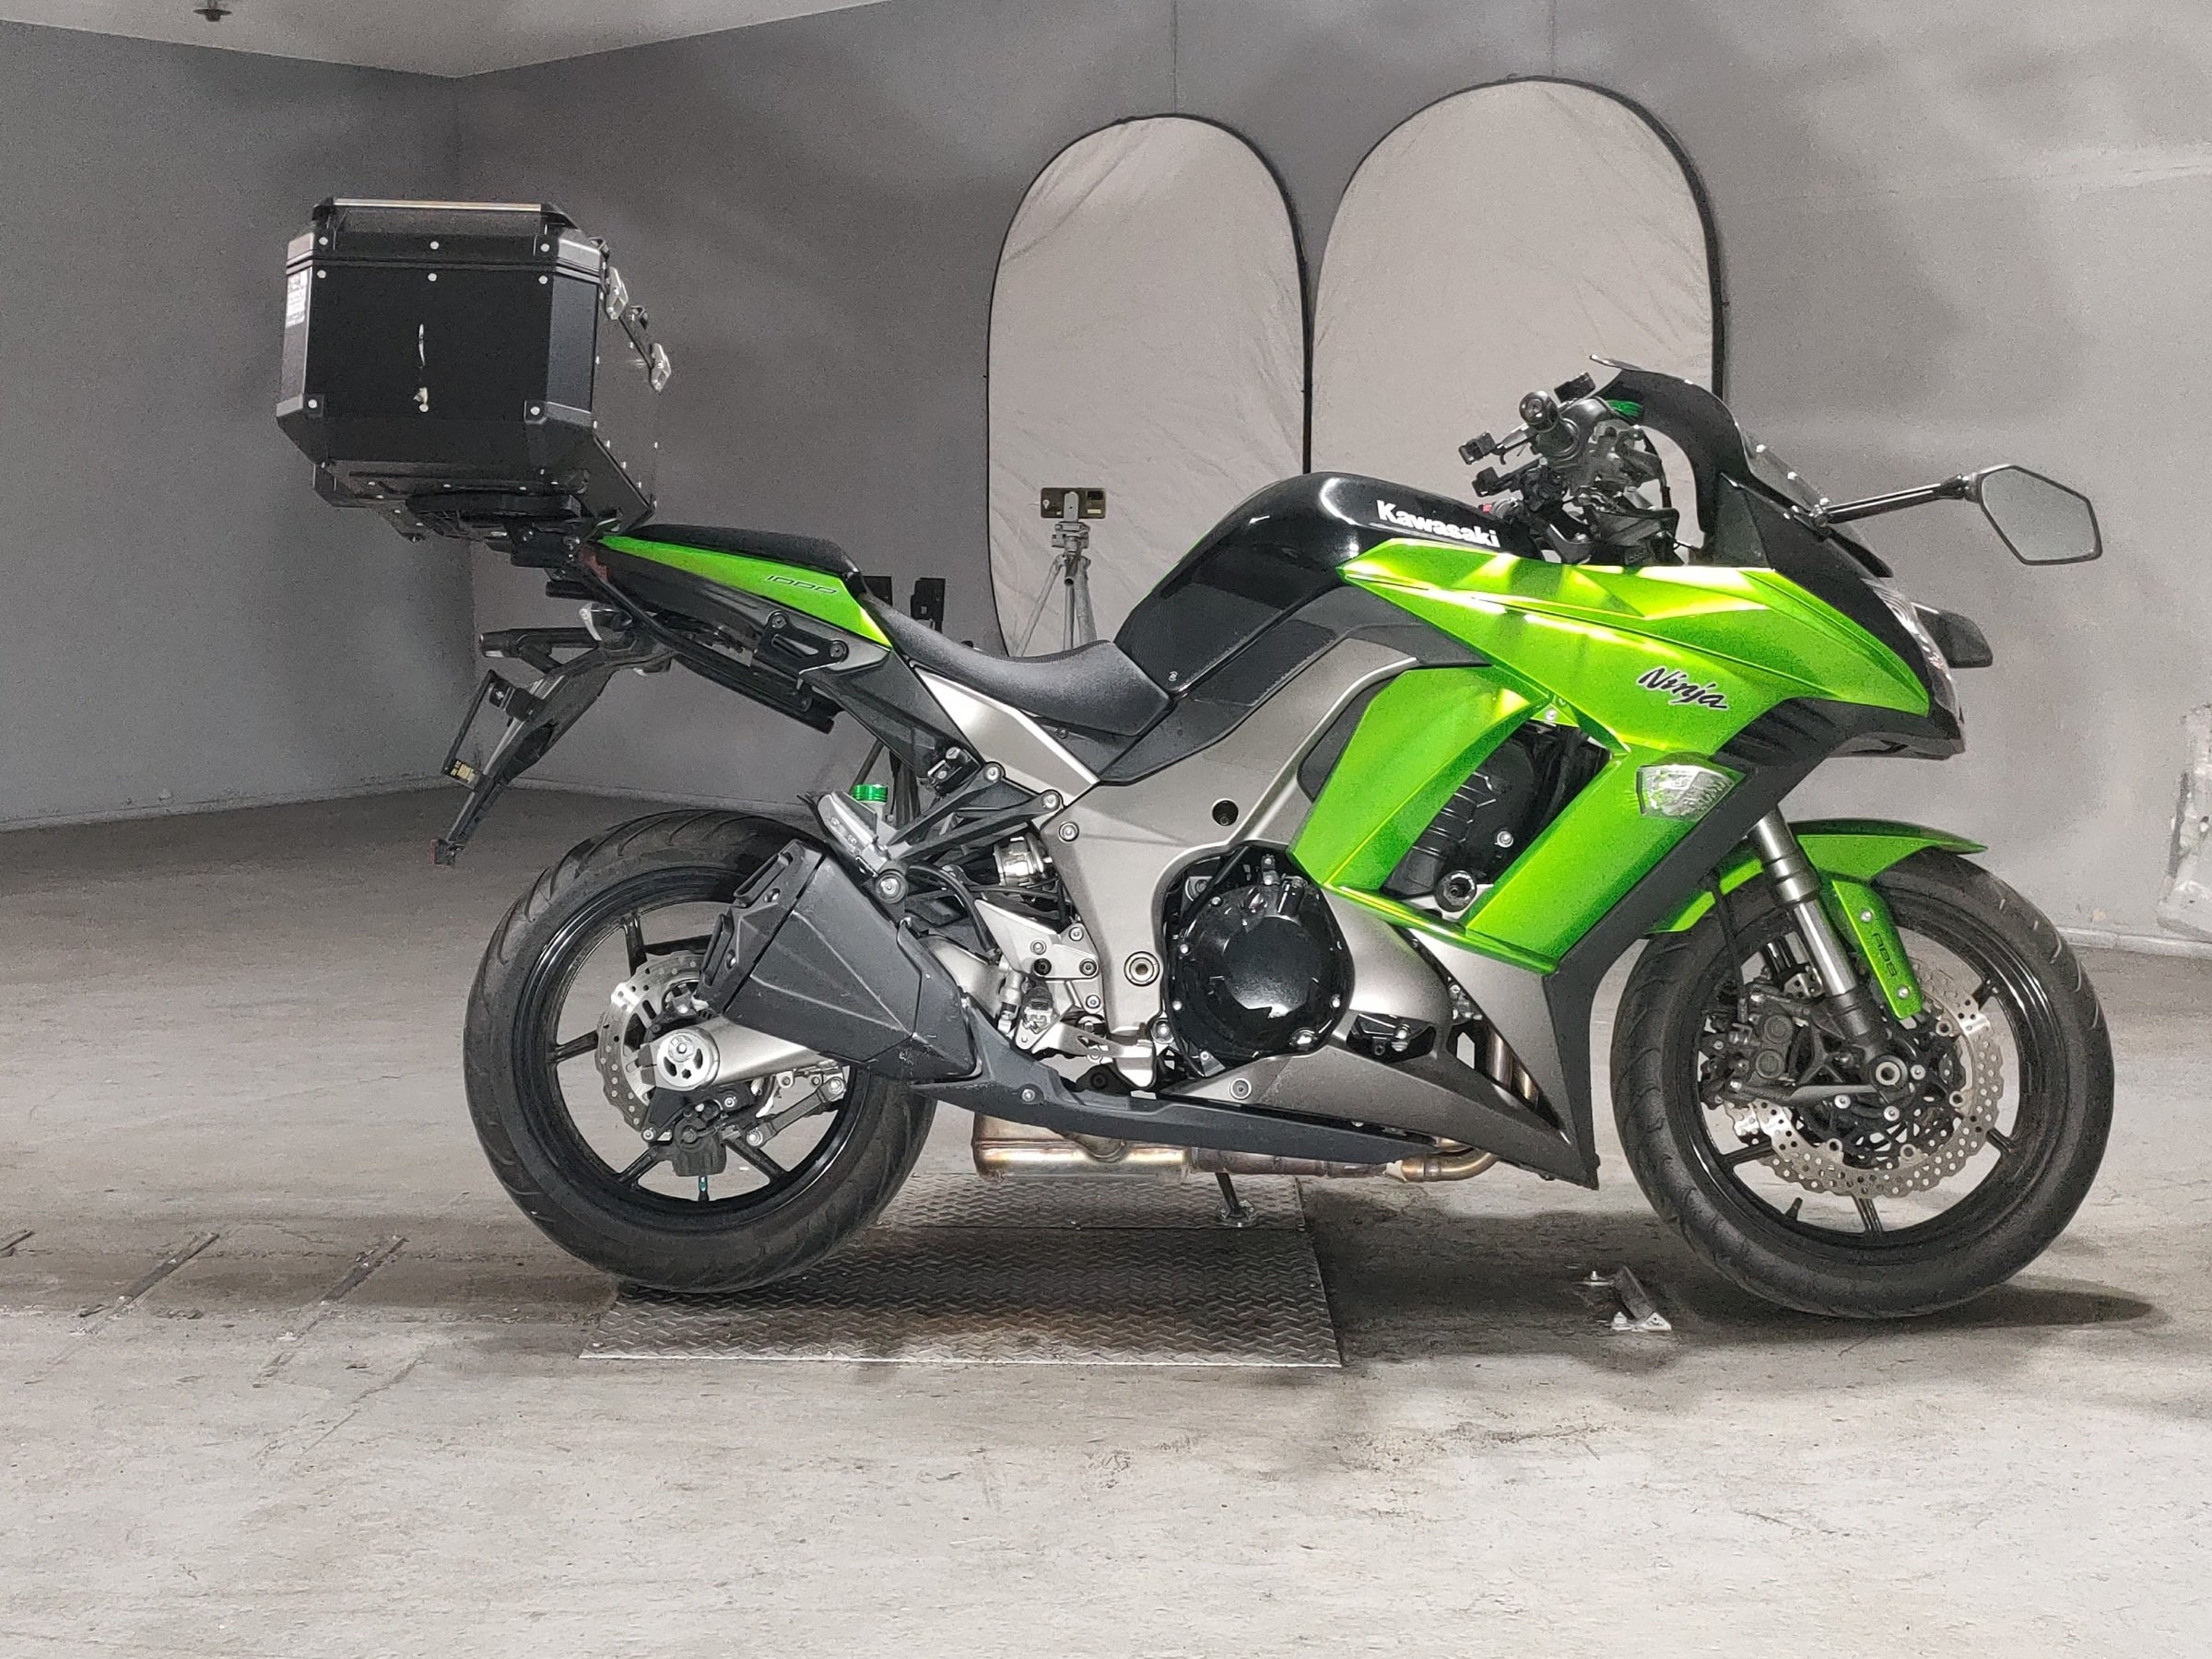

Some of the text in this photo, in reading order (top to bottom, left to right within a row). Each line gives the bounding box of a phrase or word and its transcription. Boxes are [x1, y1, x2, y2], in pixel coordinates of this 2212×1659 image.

[1376, 500, 1500, 547] Kawasaki
[766, 575, 837, 594] 1000
[1637, 666, 1728, 710] Ninja
[1872, 933, 1898, 977] ABS
